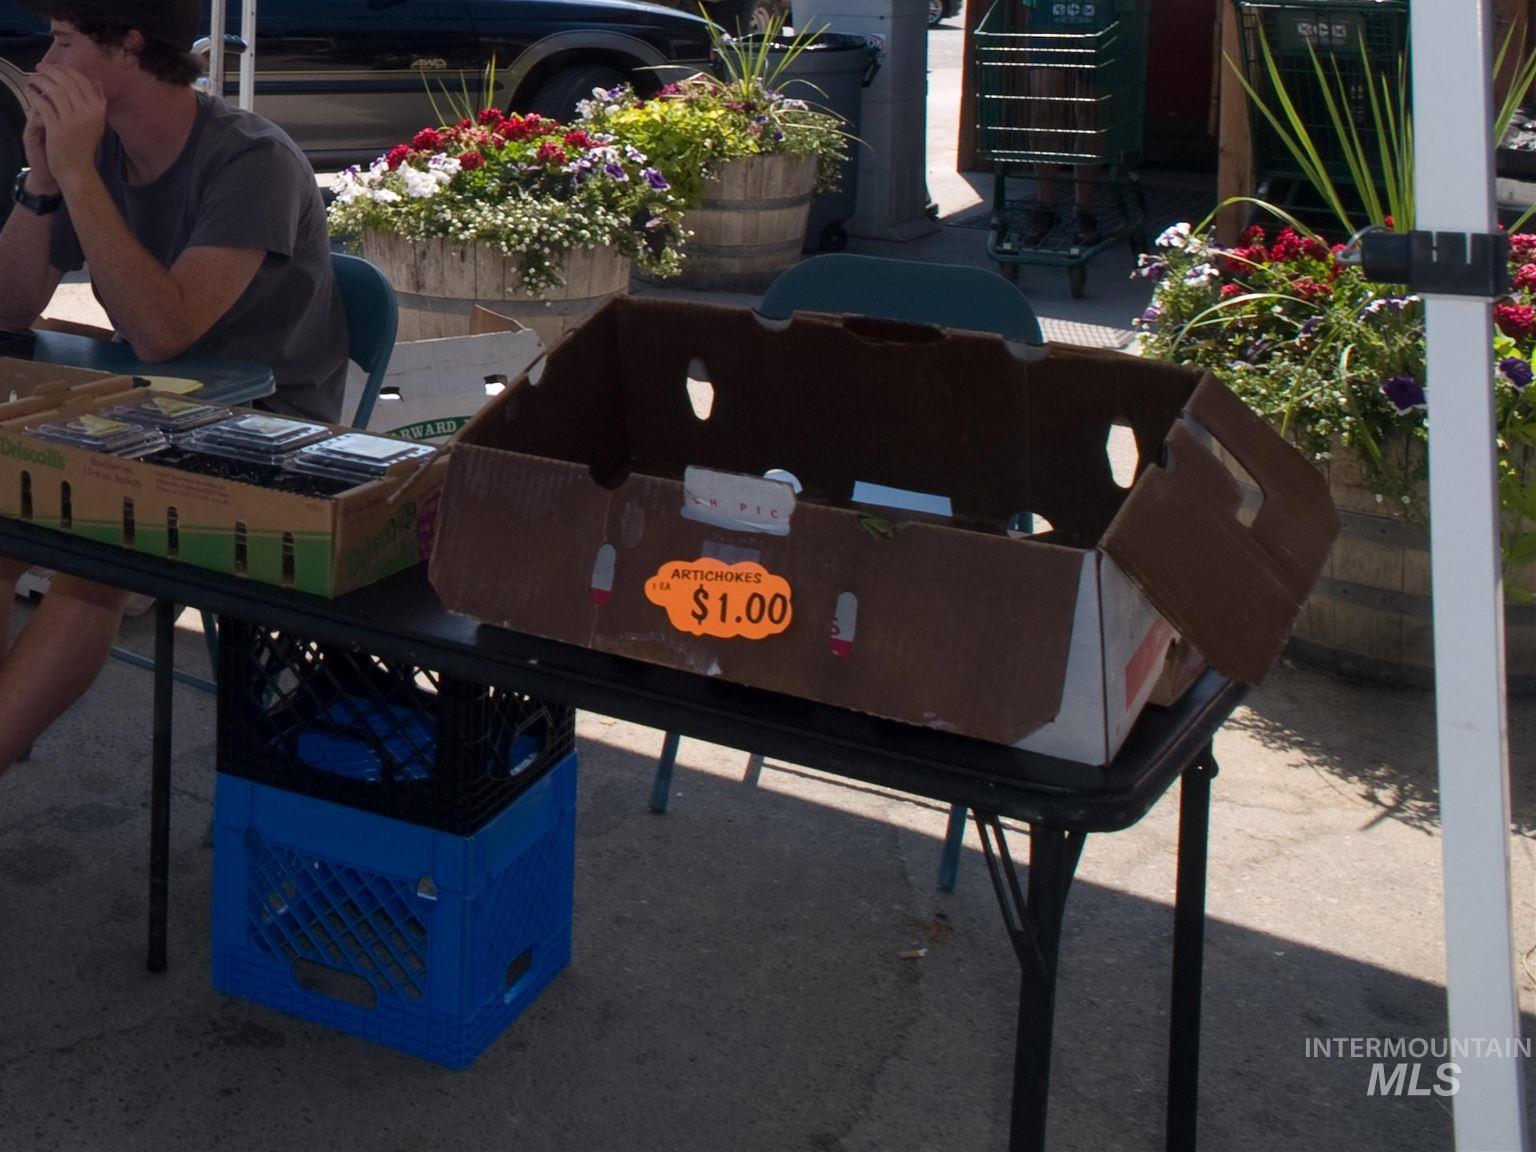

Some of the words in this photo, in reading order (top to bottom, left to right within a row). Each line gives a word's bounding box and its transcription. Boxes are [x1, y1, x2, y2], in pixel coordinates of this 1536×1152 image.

[671, 569, 762, 584] ARTICHOKES
[659, 582, 671, 591] EA
[691, 584, 789, 626] $1.00
